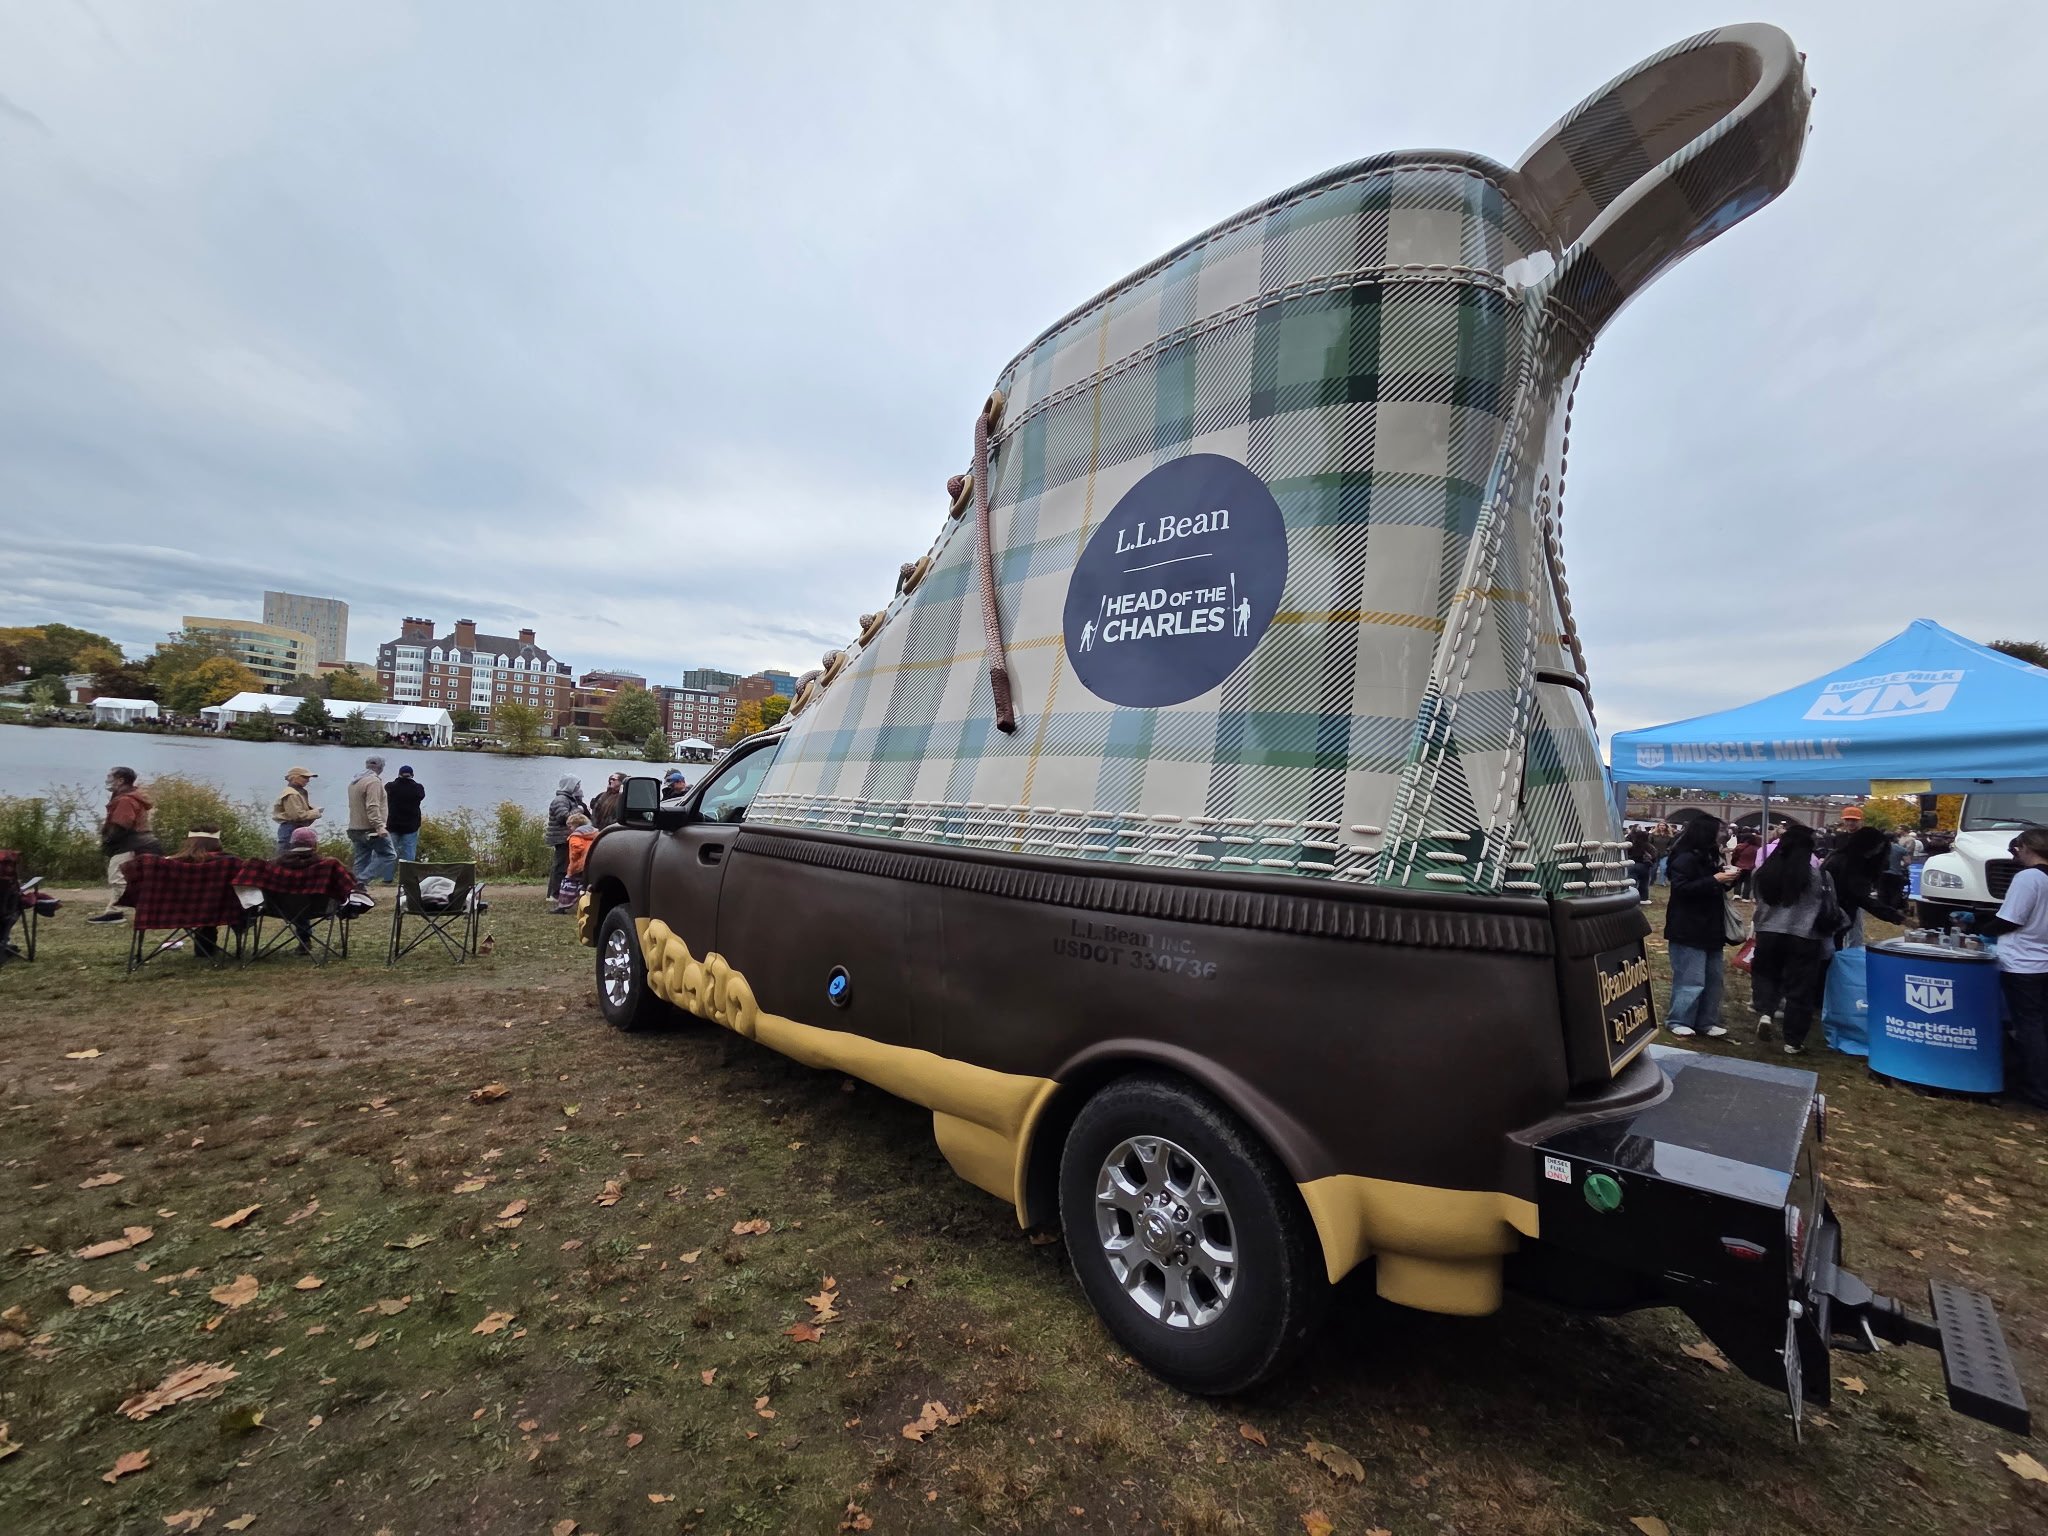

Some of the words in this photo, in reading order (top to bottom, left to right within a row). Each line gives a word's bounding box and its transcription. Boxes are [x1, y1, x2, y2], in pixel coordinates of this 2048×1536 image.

[1115, 509, 1230, 554] L.L.Bean
[1106, 588, 1166, 617] HEAD
[1169, 592, 1192, 608] OF
[1195, 586, 1226, 603] THE
[1103, 606, 1225, 642] CHARLES
[1830, 673, 1900, 692] MUSCLE
[1905, 671, 1955, 681] MILK
[1801, 683, 1959, 721] MM
[1671, 740, 1767, 763] MUSCLE
[1070, 918, 1153, 949] L.L.Bean
[1161, 936, 1196, 955] INC.
[1053, 938, 1124, 966] USDOT
[1130, 950, 1217, 981] 330736
[1905, 983, 1953, 1014] MM
[1885, 1015, 1905, 1027] No
[1906, 1021, 1976, 1037] artificial
[1885, 1025, 1978, 1045] sweeteners
[1547, 1158, 1568, 1167] DIESEL
[1547, 1171, 1569, 1181] ONLY
[1550, 1165, 1566, 1173] FUEL
